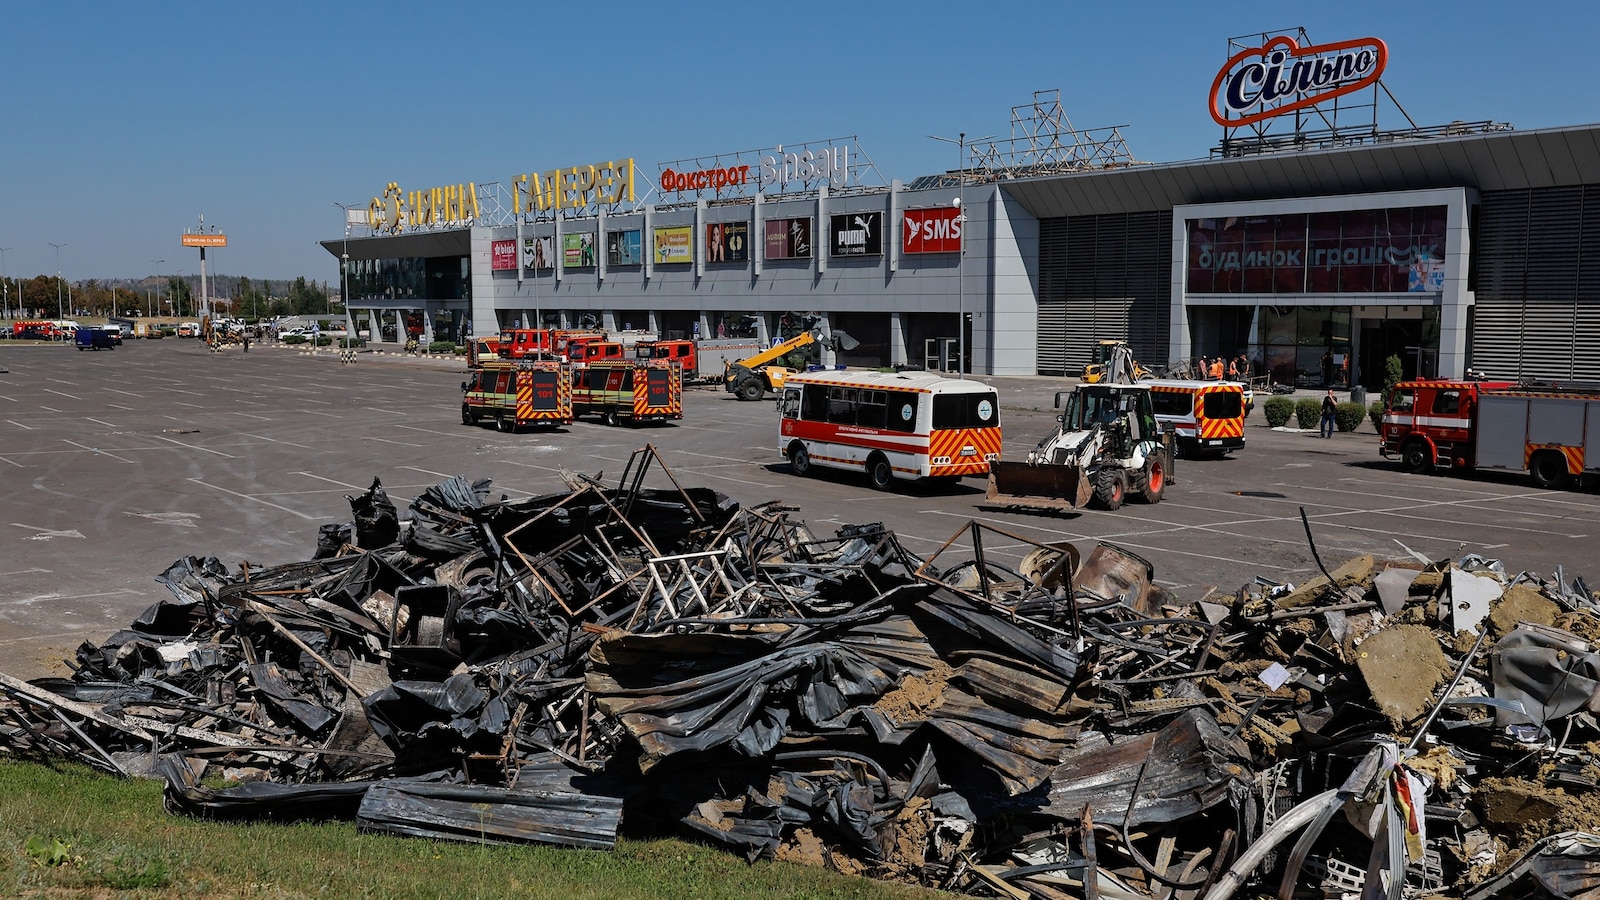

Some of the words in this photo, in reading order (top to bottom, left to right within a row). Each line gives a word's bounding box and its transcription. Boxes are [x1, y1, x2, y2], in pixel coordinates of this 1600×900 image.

[1225, 49, 1376, 113] Сільпо
[760, 144, 848, 190] sinsay
[511, 157, 634, 214] ГАЛЕРЕЯ
[661, 167, 750, 193] Фокстрот
[838, 230, 866, 246] PUMA
[923, 217, 961, 241] SMS
[1198, 245, 1302, 274] будинок
[537, 390, 553, 399] 101
[651, 387, 666, 395] 101
[1391, 426, 1398, 434] 10
